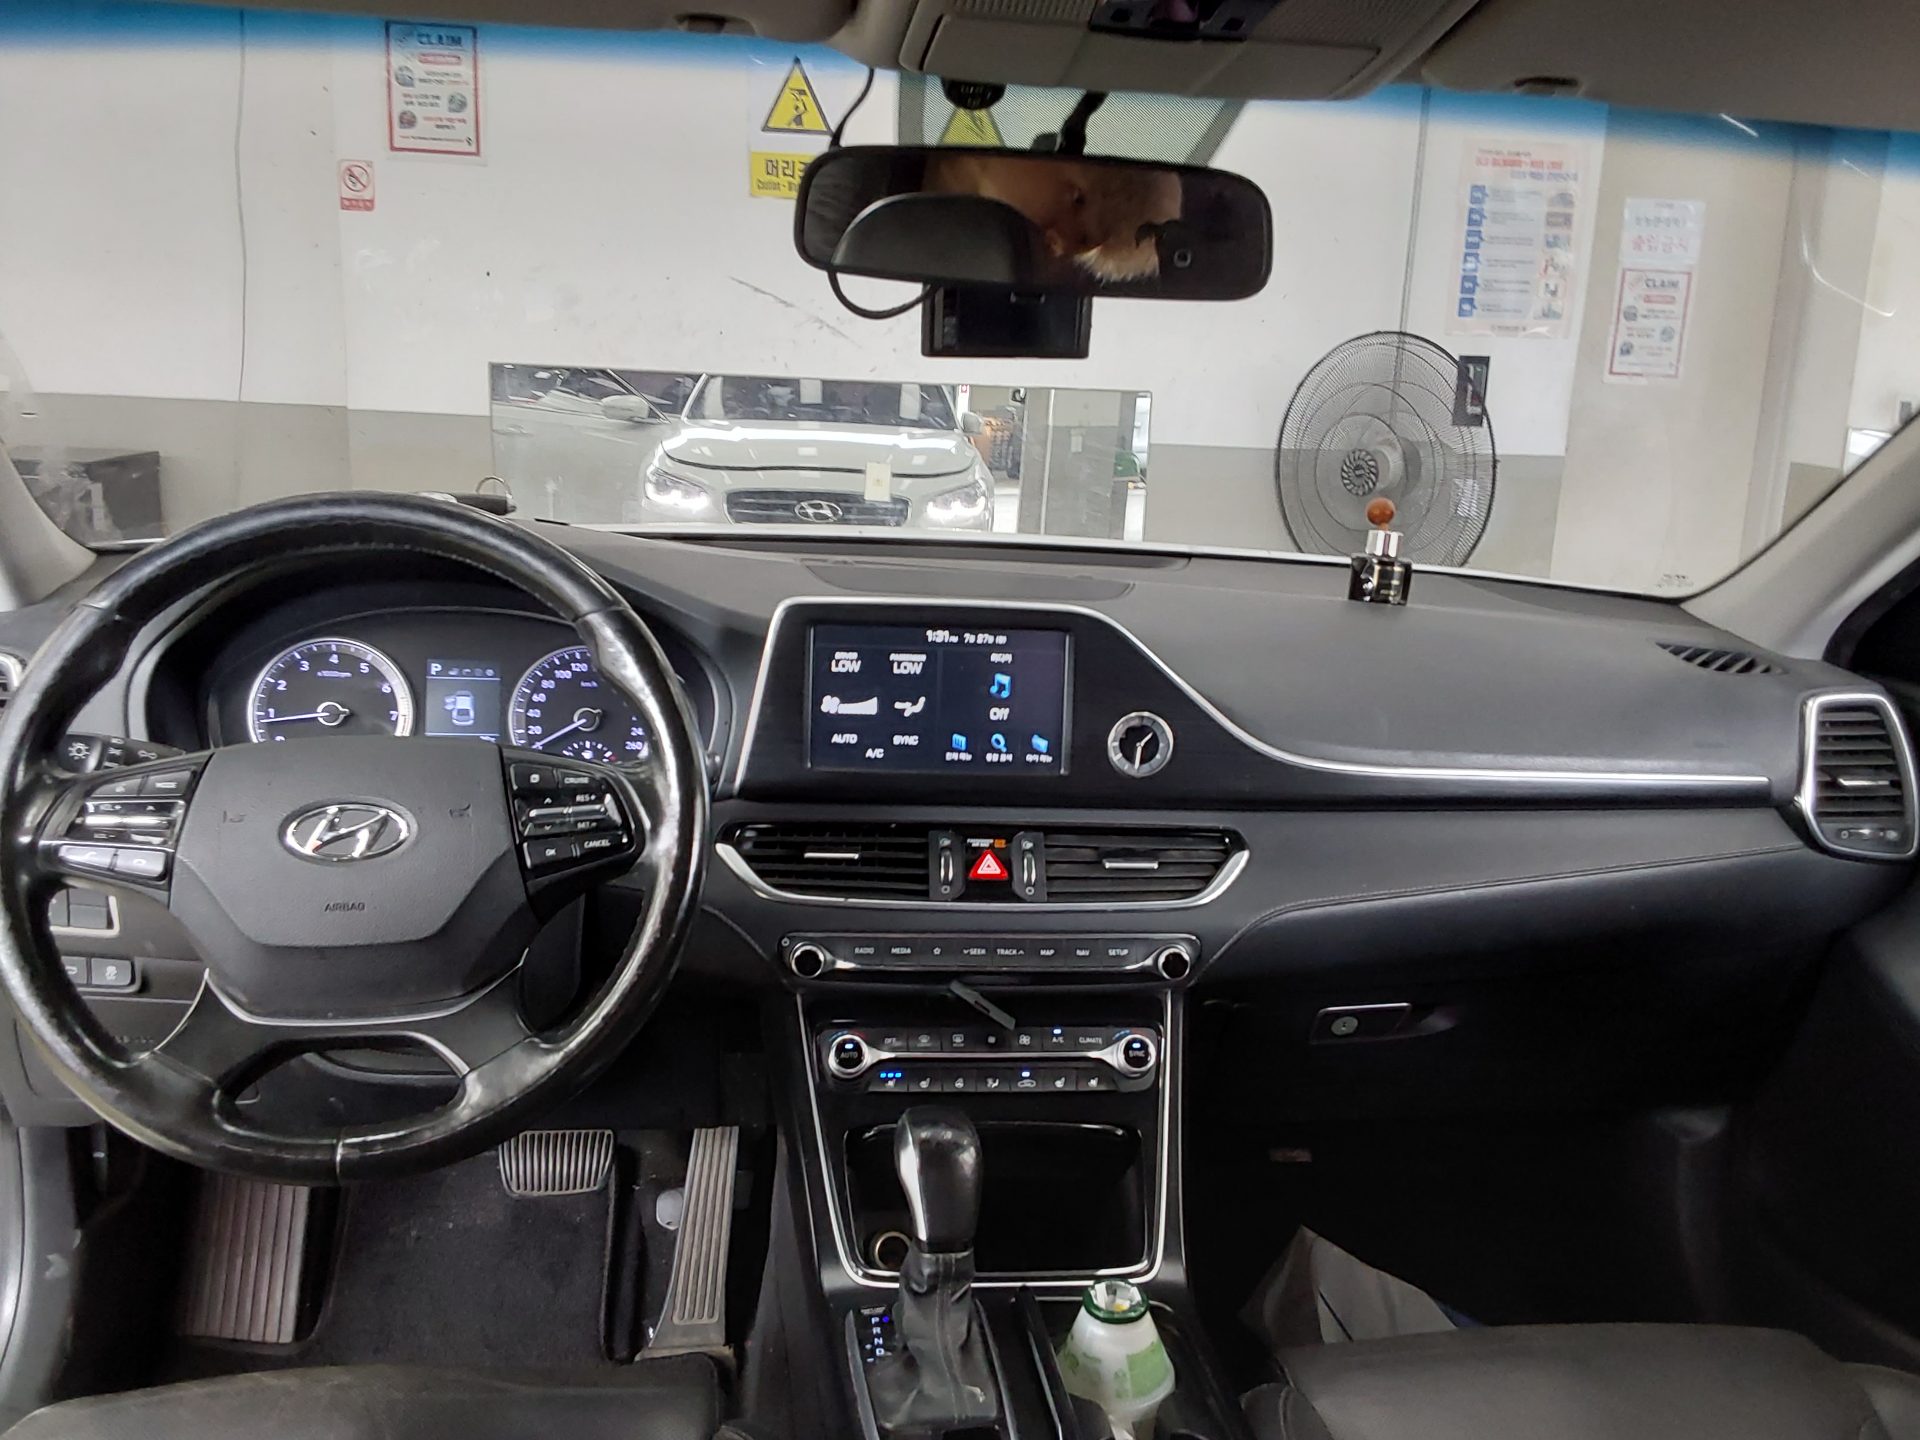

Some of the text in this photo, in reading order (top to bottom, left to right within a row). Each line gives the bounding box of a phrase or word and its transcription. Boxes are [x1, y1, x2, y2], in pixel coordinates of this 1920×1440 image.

[329, 653, 339, 664] 4
[300, 661, 310, 672] 3
[359, 663, 370, 673] 5
[430, 663, 442, 676] P
[571, 662, 588, 672] 120
[831, 659, 862, 673] LOW
[893, 661, 923, 675] LOW
[554, 669, 573, 679] 100
[276, 680, 287, 691] 2
[381, 684, 392, 694] 6
[531, 693, 547, 703] 60
[268, 708, 275, 718] 1
[389, 710, 399, 721] 7
[527, 725, 542, 735] 20
[831, 733, 858, 744] AUTO
[892, 735, 919, 746] SYNC
[624, 741, 643, 751] 260
[865, 748, 884, 759] A/C
[584, 839, 611, 849] CANCEL
[545, 848, 557, 857] OK
[324, 902, 366, 912] AIRBAG
[854, 947, 875, 955] RADIO
[890, 947, 912, 955] MEDIA
[969, 948, 987, 956] SEEK
[996, 948, 1017, 956] TRACK
[1079, 1036, 1103, 1045] CLIMATE
[840, 1050, 858, 1059] AUTO
[871, 1316, 880, 1325] P
[872, 1326, 881, 1335] R
[874, 1337, 883, 1346] N
[876, 1347, 885, 1357] D
